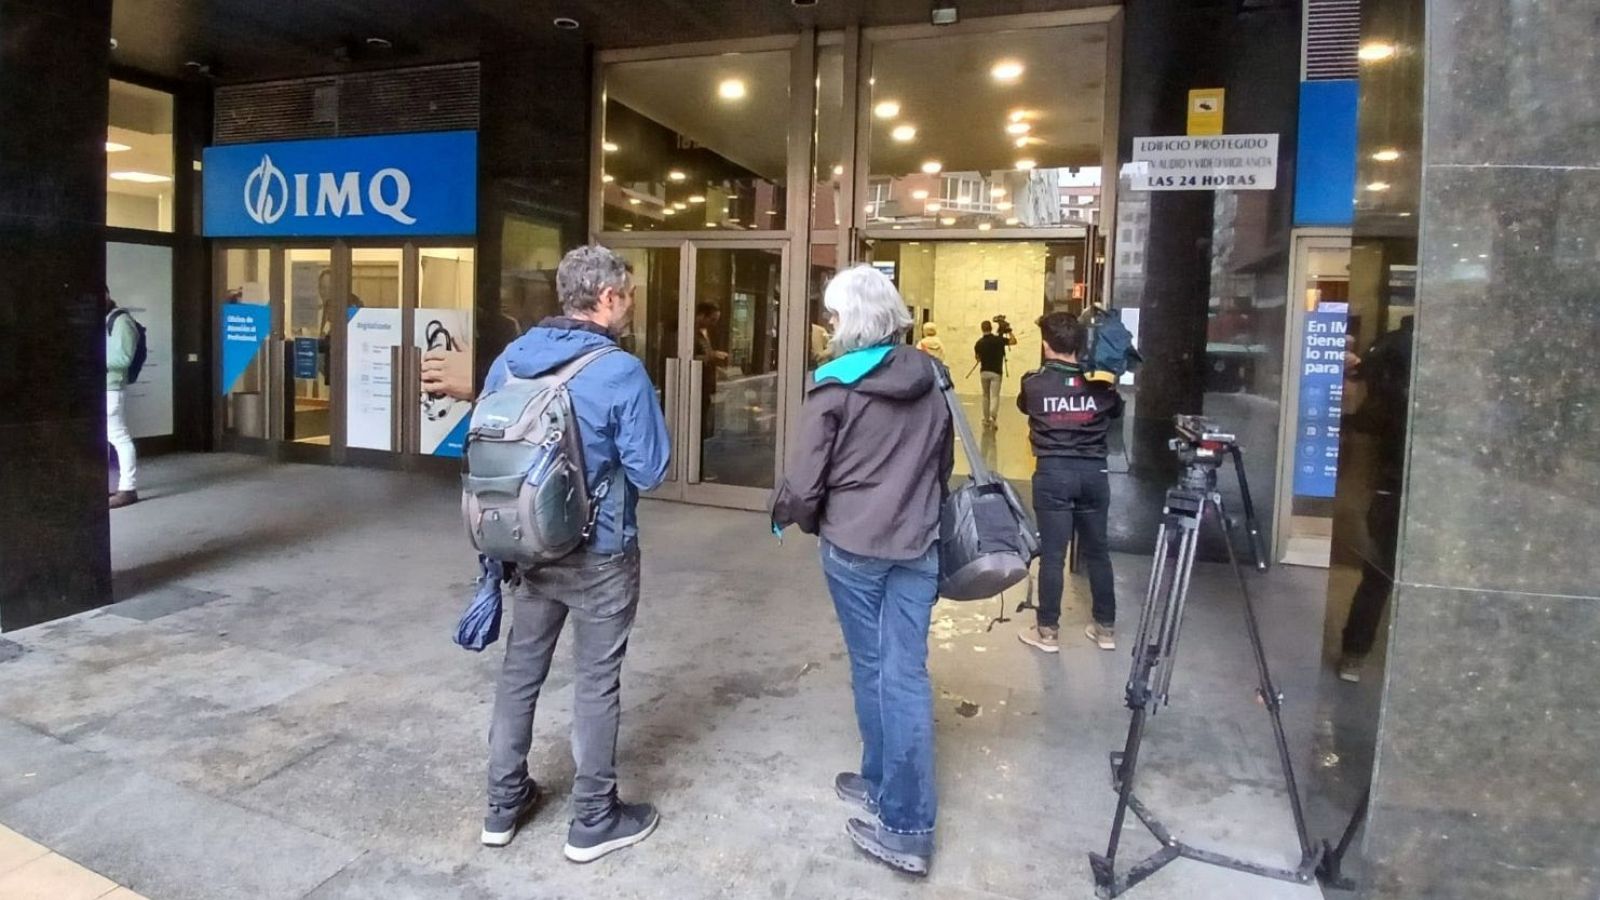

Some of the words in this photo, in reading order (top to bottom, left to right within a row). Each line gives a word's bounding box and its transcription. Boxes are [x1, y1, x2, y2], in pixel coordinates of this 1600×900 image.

[1141, 140, 1190, 152] EDIFICIO
[1194, 138, 1268, 150] PROTEGIDO
[1159, 158, 1186, 169] AUDIO
[1148, 175, 1174, 187] LAS
[1180, 175, 1196, 186] 24
[1201, 174, 1256, 186] HORAS
[294, 168, 417, 225] IMQ
[1307, 320, 1327, 333] En
[1305, 347, 1320, 360] lo
[1304, 363, 1340, 376] para
[1043, 395, 1098, 412] ITALIA
